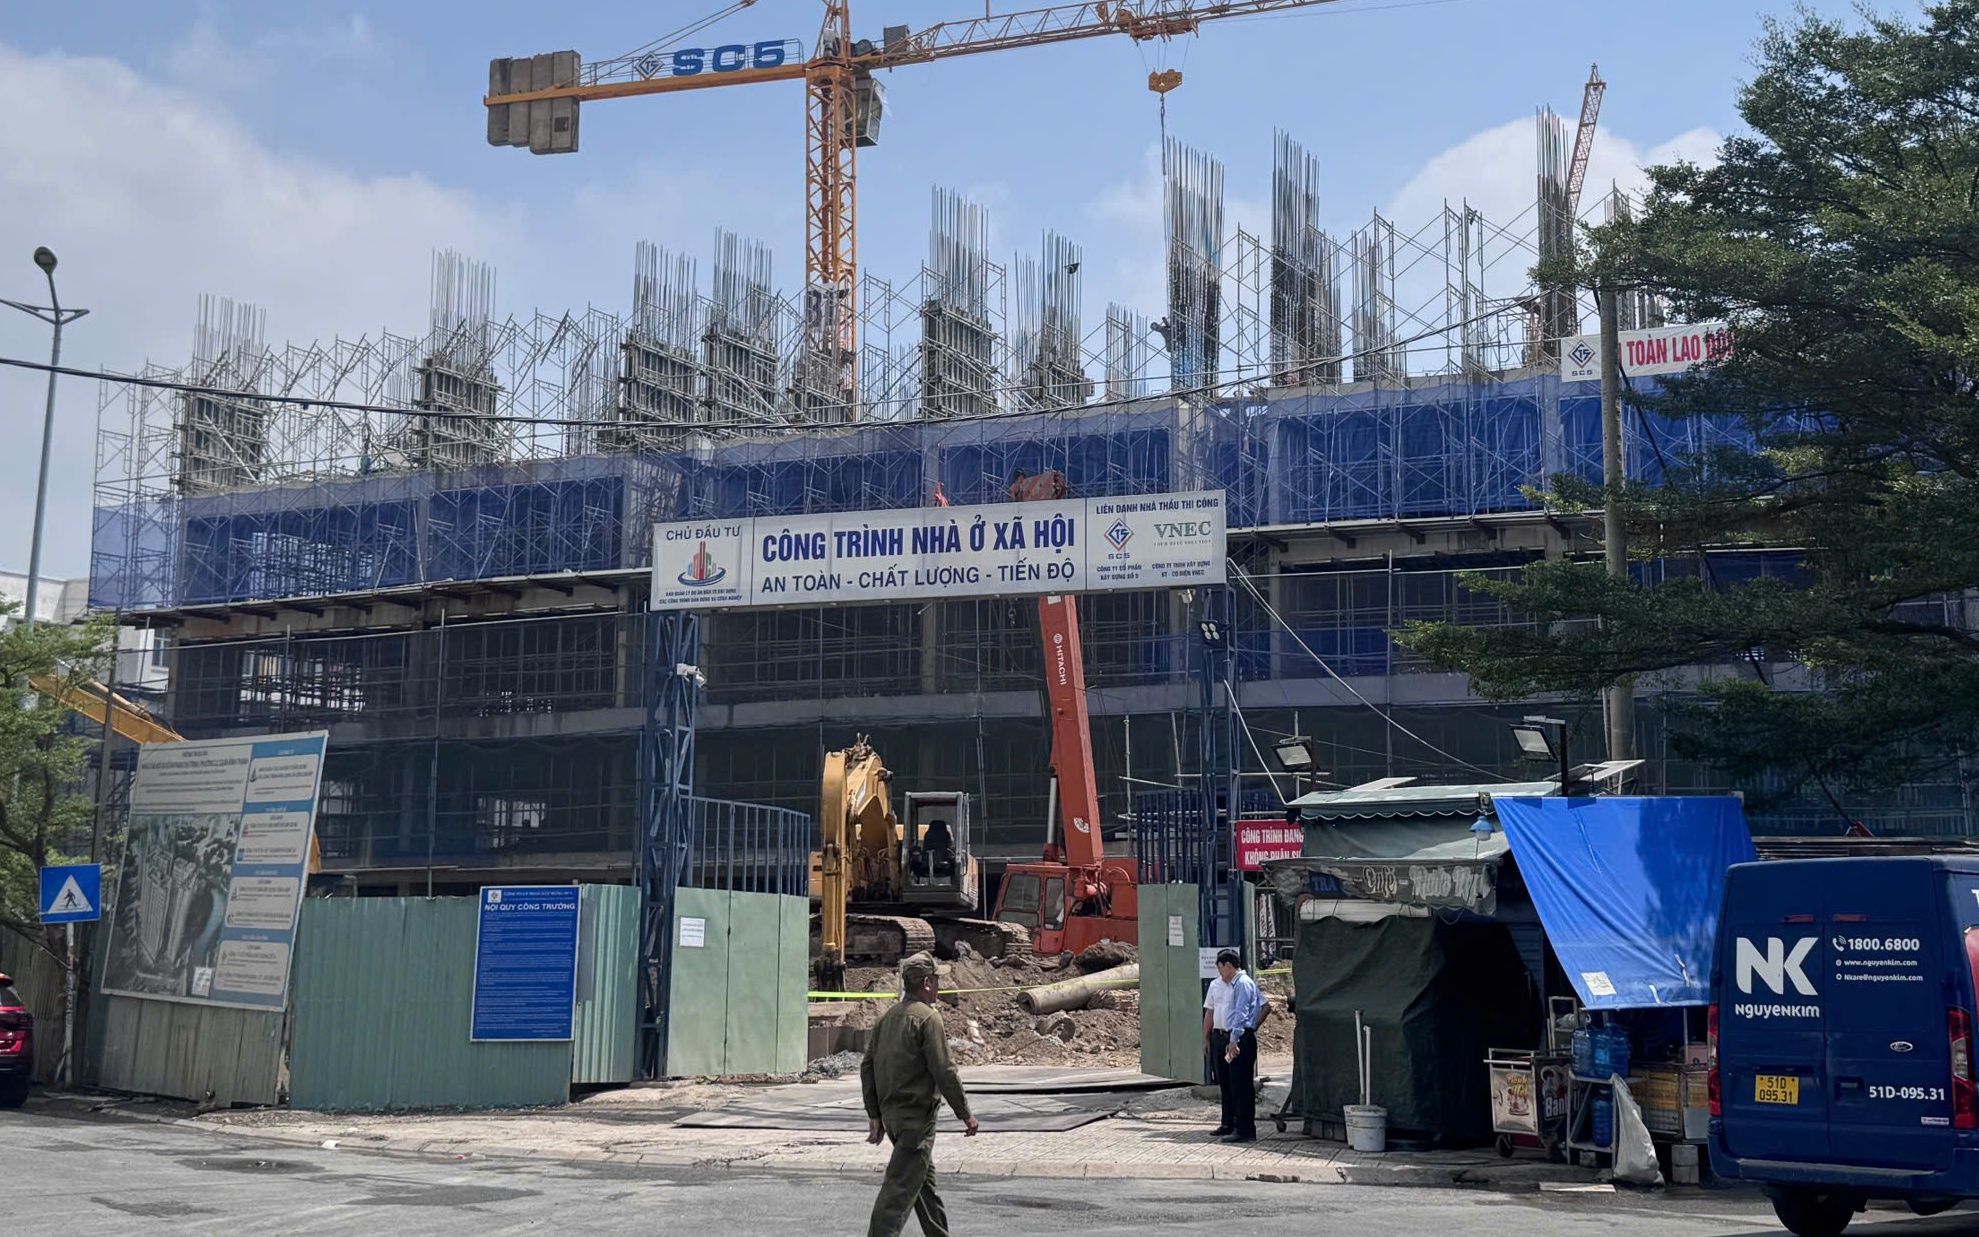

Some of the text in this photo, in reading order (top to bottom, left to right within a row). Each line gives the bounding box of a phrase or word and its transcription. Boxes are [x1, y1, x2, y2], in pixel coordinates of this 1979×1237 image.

[672, 39, 786, 76] SC5
[1627, 334, 1668, 366] TOÀN
[1672, 335, 1701, 362] LAO
[1571, 369, 1593, 377] SC5
[1096, 503, 1114, 515] LIÊN
[1116, 504, 1138, 514] DANH
[1139, 500, 1157, 512] NHÀ
[1181, 500, 1194, 509] THI
[1196, 497, 1219, 509] CÔNG
[666, 525, 692, 541] CHỦ
[724, 524, 741, 537] TƯ
[763, 513, 1075, 562] CÔNG TRÌNH NHÀ Ở XÃ HỘI
[1153, 520, 1211, 539] VNEC
[761, 576, 786, 593] AN
[792, 570, 841, 592] TOÀN
[858, 563, 909, 589] CHẤT
[914, 565, 979, 588] LƯỢNG
[997, 557, 1040, 582] TIẾN
[1047, 557, 1075, 582] ĐỘ
[1056, 645, 1067, 685] HITACHI
[1241, 826, 1261, 844] CÔNG
[1261, 826, 1283, 844] TRÌNH
[517, 902, 540, 911] CÔNG
[1848, 938, 1920, 951] 1800.6800
[1736, 937, 1819, 996] NK
[1844, 959, 1918, 967] www.nguyenkim.com
[1767, 1077, 1787, 1089] 51D
[1759, 1089, 1793, 1103] 095.31
[1869, 1086, 1945, 1101] 51D-095.31
